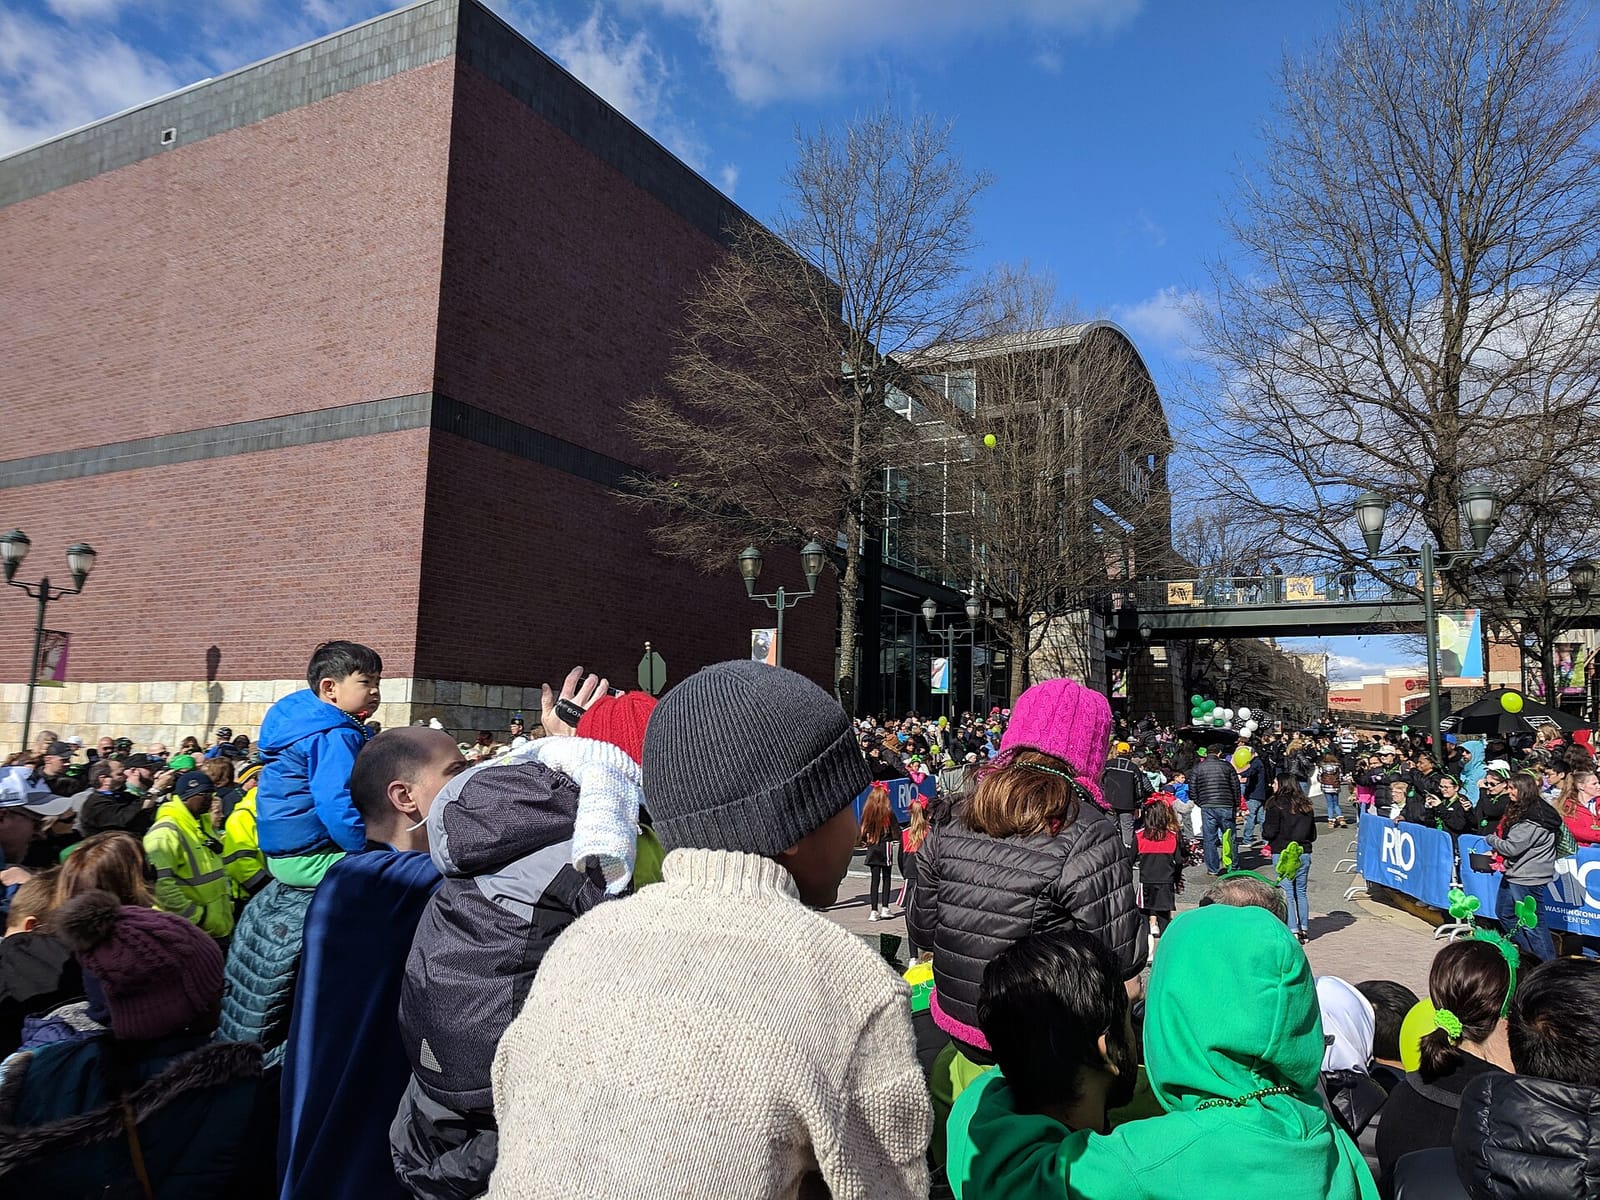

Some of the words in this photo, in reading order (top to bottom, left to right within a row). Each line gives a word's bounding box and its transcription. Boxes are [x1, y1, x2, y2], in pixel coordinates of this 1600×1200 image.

[898, 783, 919, 808] RIO
[1382, 826, 1416, 871] RIO
[1563, 915, 1590, 925] CENTER
